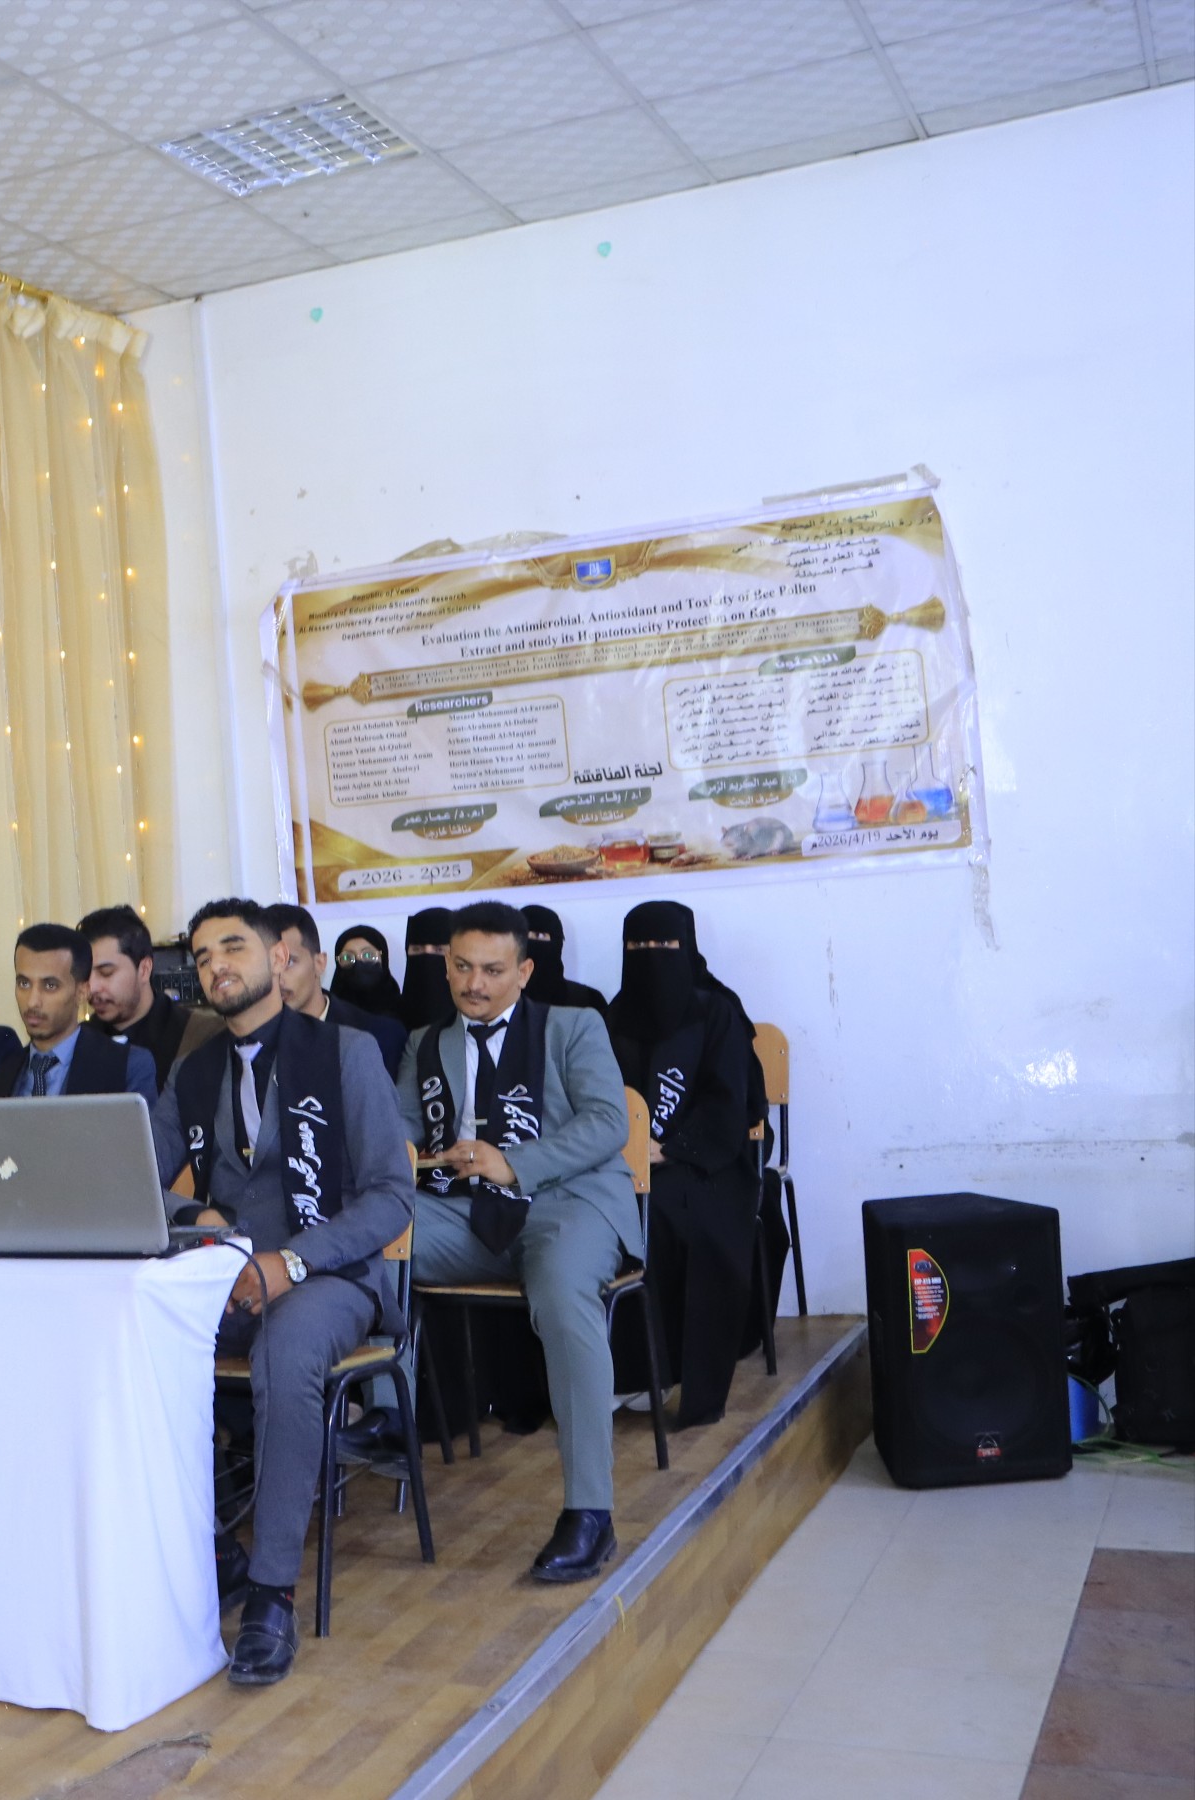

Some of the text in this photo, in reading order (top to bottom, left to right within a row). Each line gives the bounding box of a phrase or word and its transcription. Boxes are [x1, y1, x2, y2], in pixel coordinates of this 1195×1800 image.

[385, 588, 394, 597] of
[396, 586, 420, 595] Yemen
[431, 592, 466, 603] Research
[375, 612, 404, 622] Faculty
[406, 611, 414, 619] of
[416, 609, 445, 619] Medical
[421, 630, 480, 646] Evaluation
[484, 626, 501, 638] the
[589, 605, 657, 622] Antioxidant
[661, 600, 682, 614] and
[779, 582, 817, 597] Pollen
[341, 628, 384, 641] Department
[386, 626, 394, 635] of
[460, 644, 502, 659] Extract
[505, 639, 525, 652] and
[528, 635, 558, 648] study
[561, 633, 575, 643] its
[731, 612, 745, 620] on
[414, 694, 489, 713] Researchers
[573, 761, 663, 785] لجنة المناقشة
[920, 829, 939, 841] يوم
[361, 868, 403, 886] 2026
[420, 863, 461, 880] 2025
